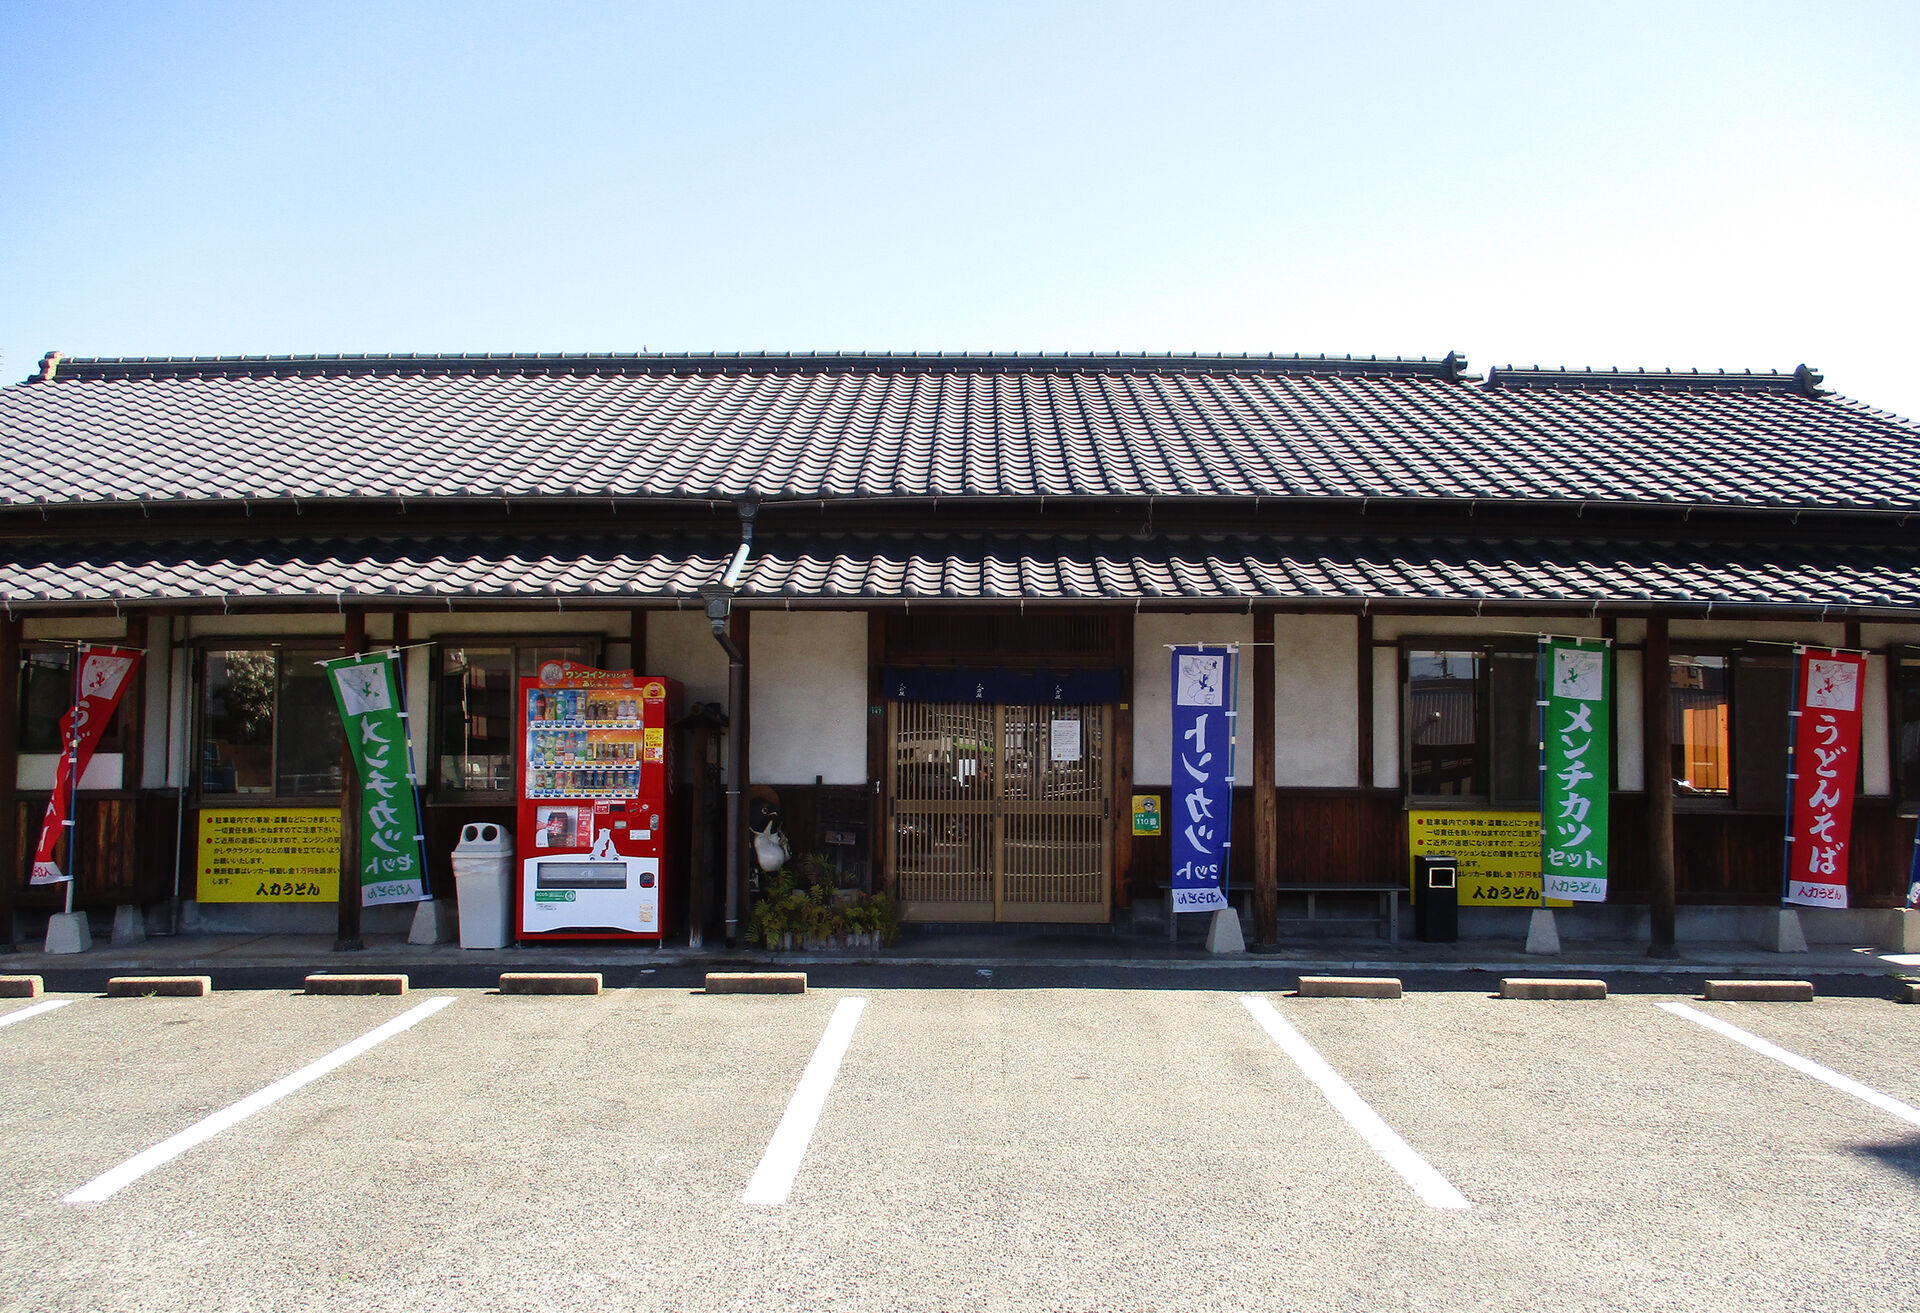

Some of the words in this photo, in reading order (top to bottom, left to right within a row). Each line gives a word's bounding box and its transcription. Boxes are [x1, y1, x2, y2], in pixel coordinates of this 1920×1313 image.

[1556, 703, 1594, 847] メンチカツ
[1808, 714, 1847, 875] うどん・そば
[1547, 847, 1603, 870] セット
[256, 882, 320, 896] 人力うどん
[1472, 885, 1540, 900] 人力うどん
[1550, 879, 1601, 894] 人力うどん
[1797, 886, 1842, 900] 人力うどん
